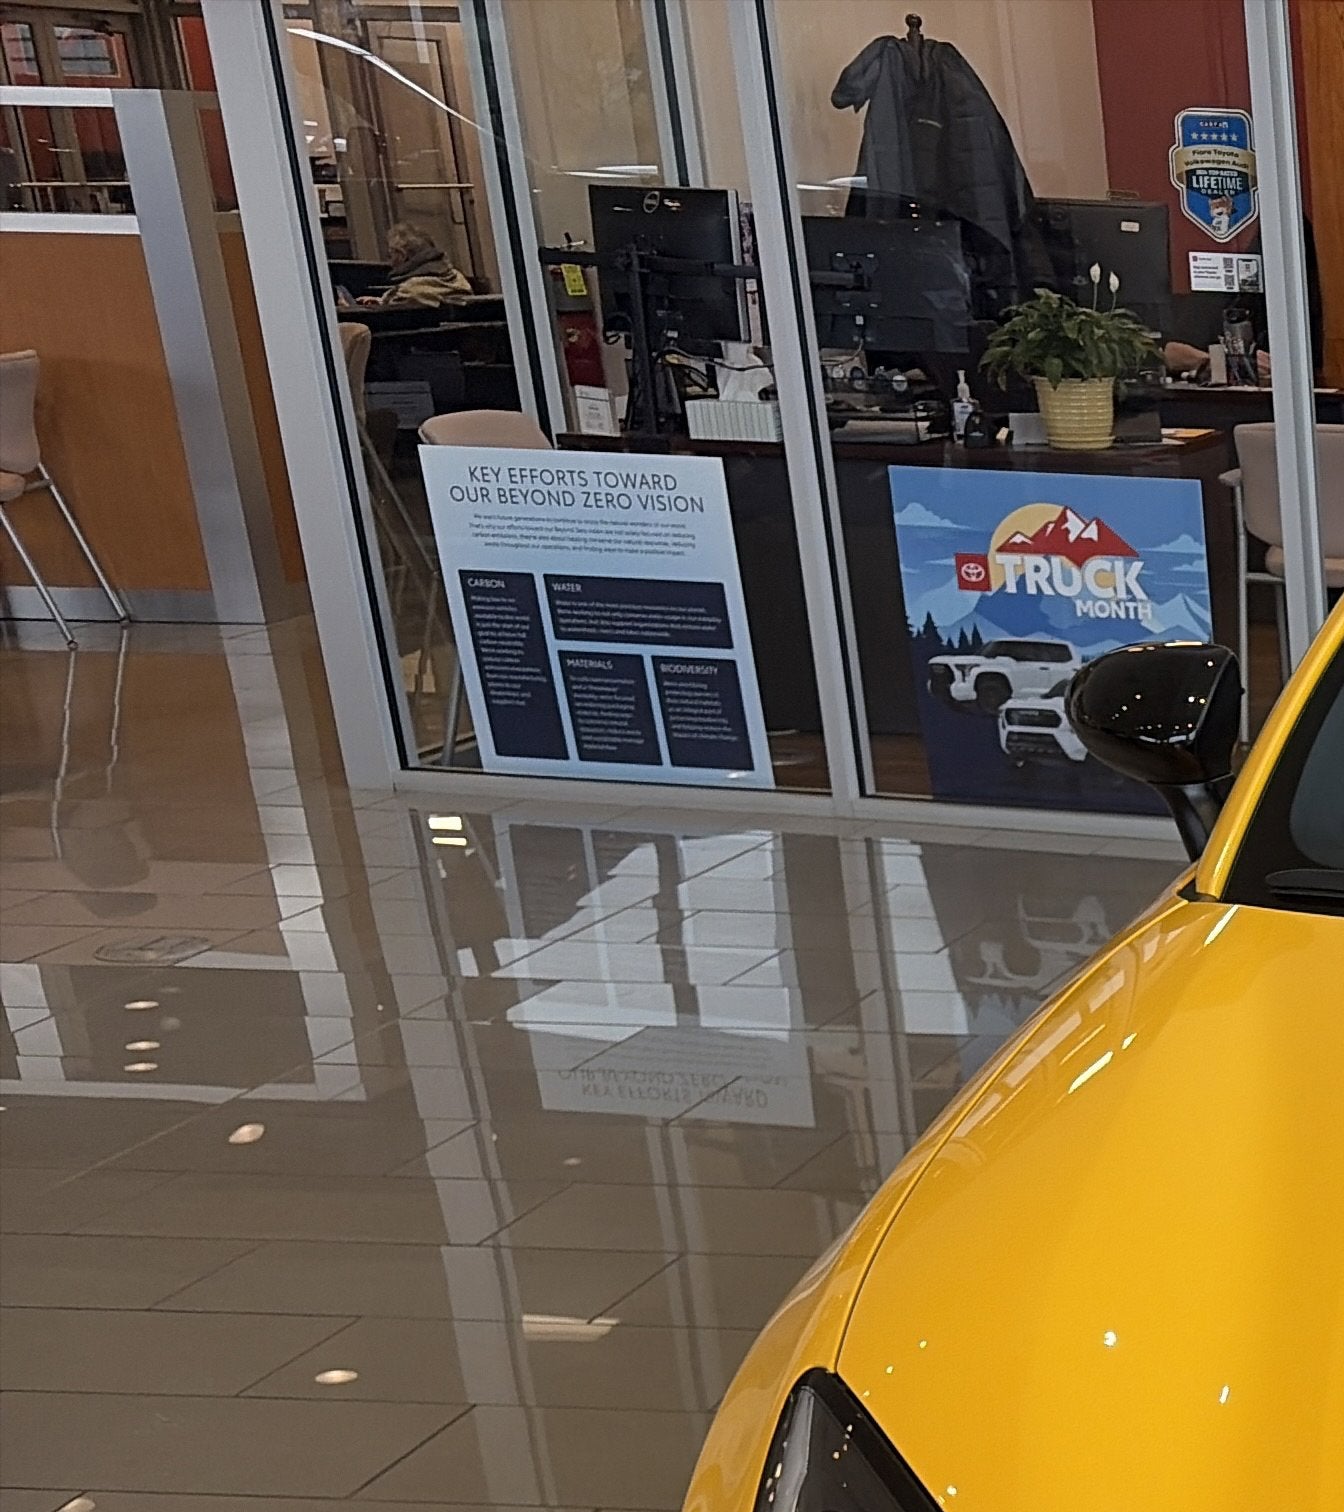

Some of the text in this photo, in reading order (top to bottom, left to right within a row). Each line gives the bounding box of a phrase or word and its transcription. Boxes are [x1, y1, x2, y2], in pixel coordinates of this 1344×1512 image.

[1192, 175, 1243, 191] LIFETIME
[468, 466, 678, 491] KEY EFFORTS TOWARD
[450, 486, 705, 513] OUR BEYOND ZERO VISION
[467, 578, 505, 588] CARBON
[552, 582, 582, 592] WATER
[996, 554, 1149, 600] TRUCK
[1075, 599, 1152, 620] MONTH
